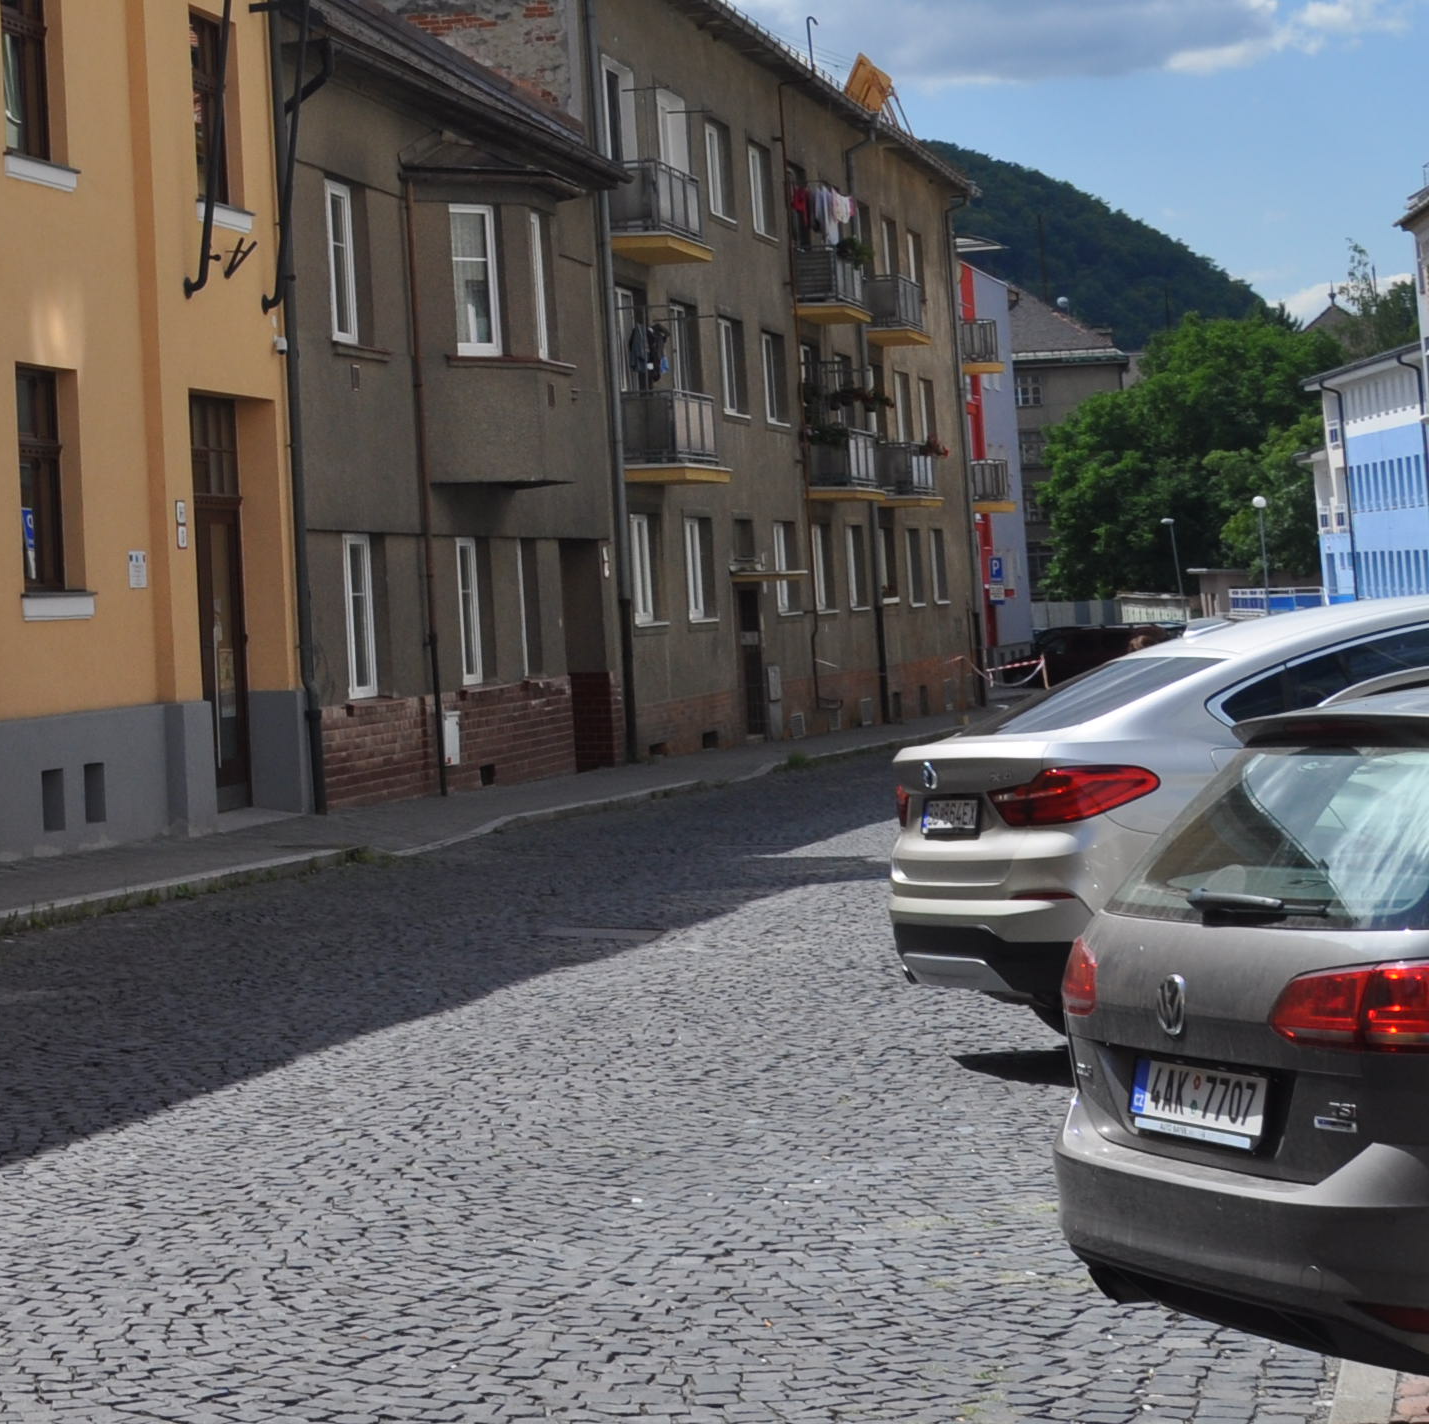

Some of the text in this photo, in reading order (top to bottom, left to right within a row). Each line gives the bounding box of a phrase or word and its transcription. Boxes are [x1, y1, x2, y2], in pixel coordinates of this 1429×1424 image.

[992, 559, 1000, 576] P
[1150, 1067, 1257, 1126] 4AK 7707
